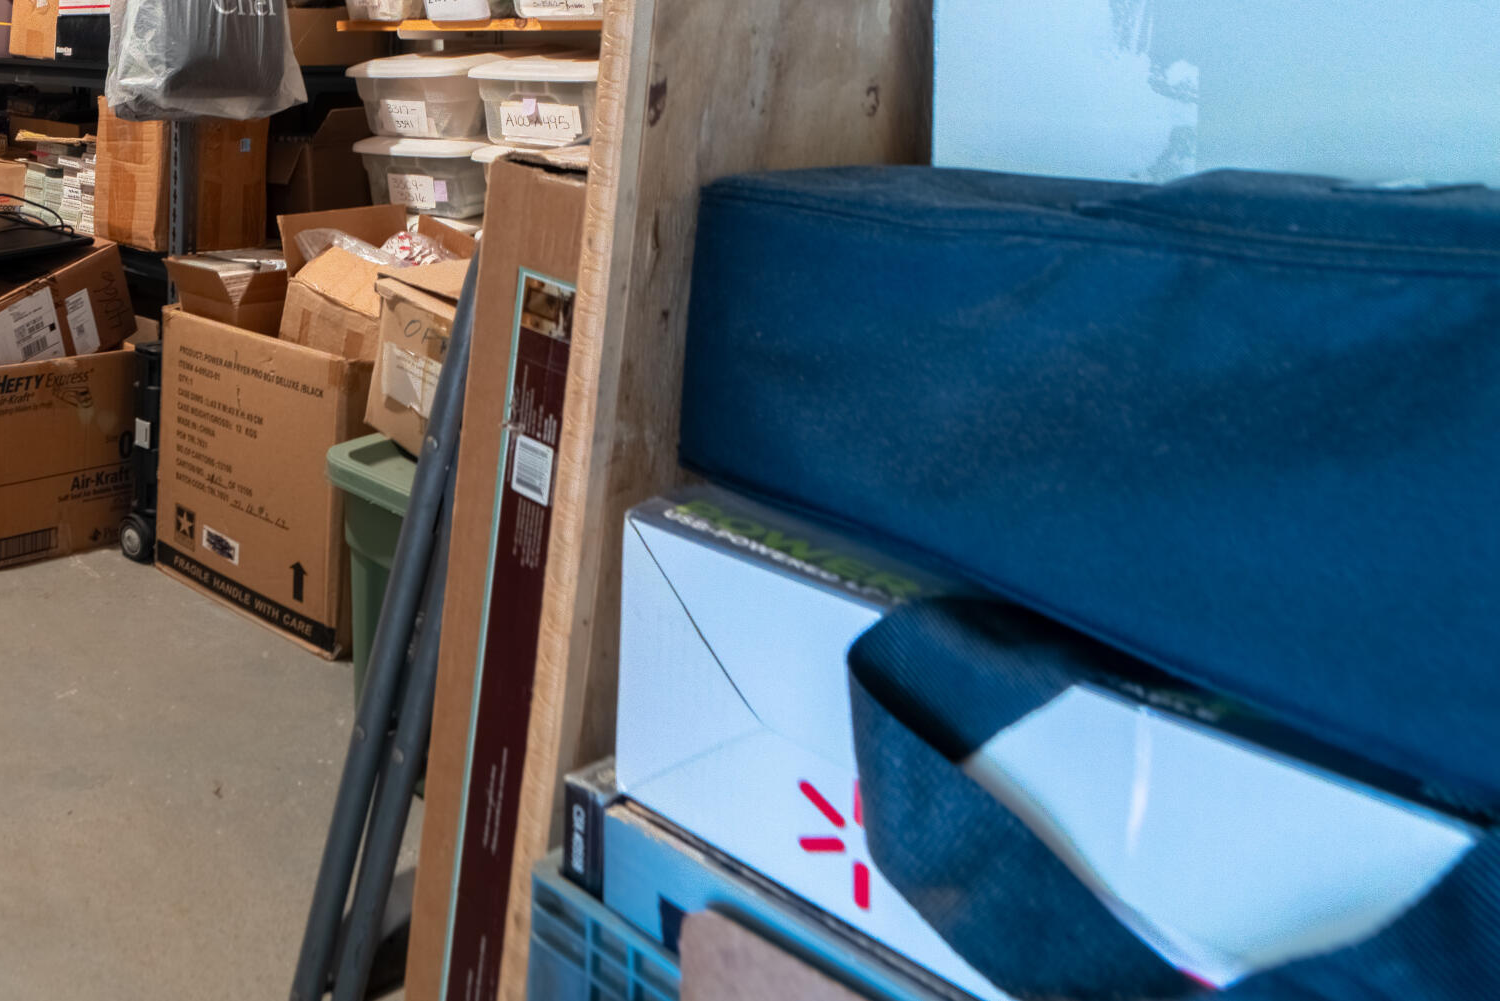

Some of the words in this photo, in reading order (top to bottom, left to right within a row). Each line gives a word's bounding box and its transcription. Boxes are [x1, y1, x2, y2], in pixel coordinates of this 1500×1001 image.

[204, 353, 224, 366] POWER
[275, 374, 300, 391] DELUXE
[70, 466, 130, 492] Air-Kraft
[173, 555, 211, 584] FRAGILE
[213, 572, 251, 604] HANDLE
[254, 597, 280, 619] WITH
[283, 613, 313, 637] CARE
